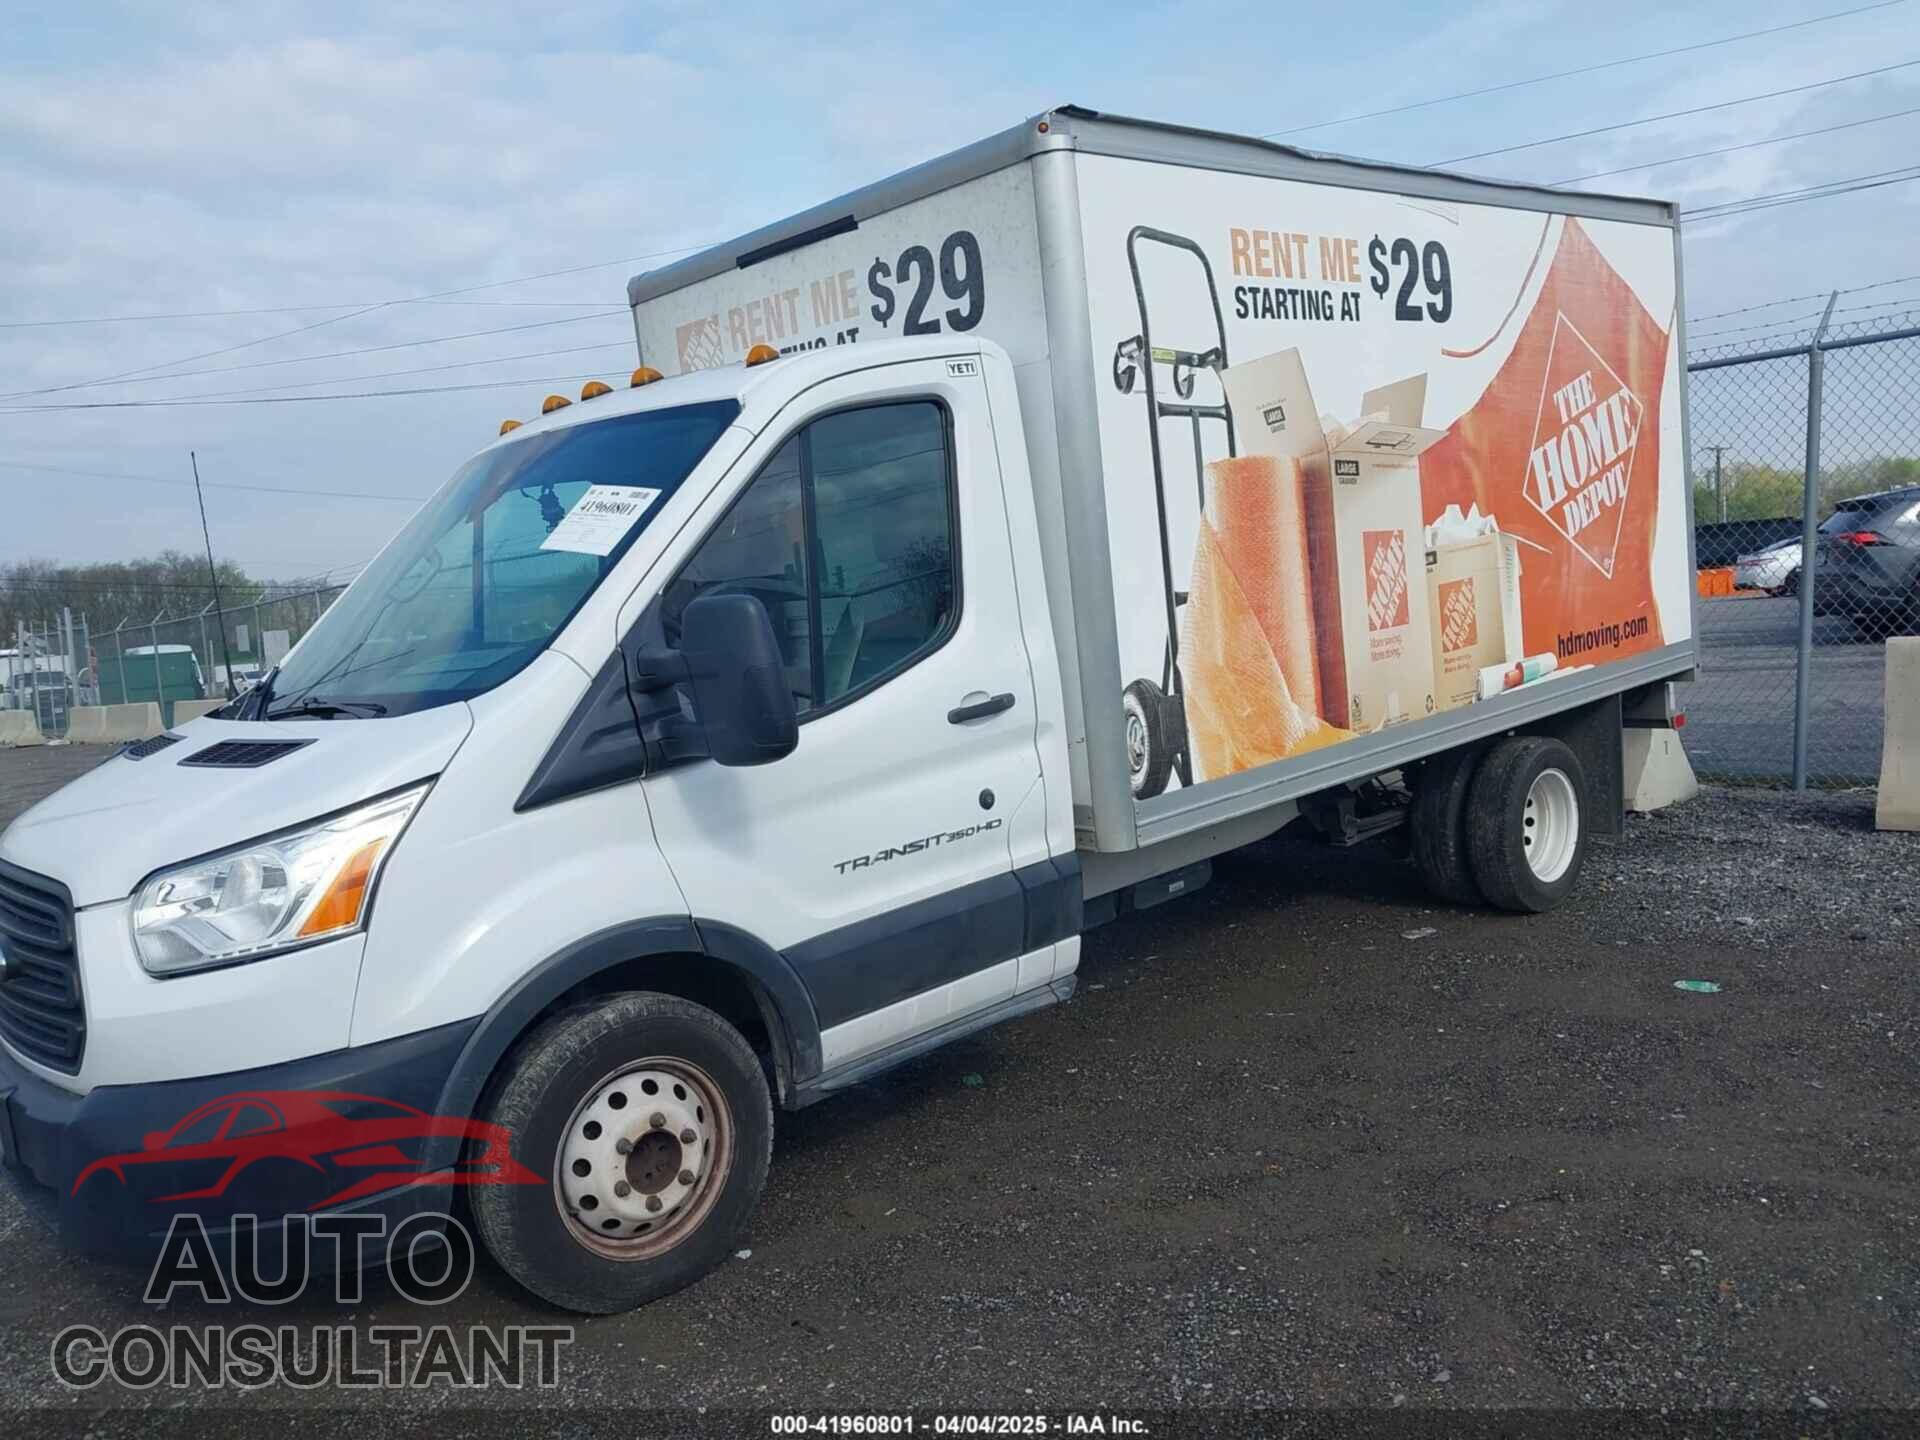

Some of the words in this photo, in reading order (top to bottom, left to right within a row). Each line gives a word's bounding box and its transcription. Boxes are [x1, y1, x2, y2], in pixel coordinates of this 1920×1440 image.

[1230, 227, 1309, 279] RENT
[1319, 236, 1362, 283] ME
[1368, 234, 1454, 323] $29
[728, 288, 801, 353] RENT
[810, 269, 860, 328] ME
[868, 230, 985, 337] $29
[1234, 285, 1334, 321] STARTING
[1340, 291, 1361, 322] AT
[948, 362, 976, 374] YETI
[1553, 370, 1596, 425] THE
[1531, 386, 1637, 513] HOME
[1562, 461, 1626, 538] DEPOT
[1558, 615, 1648, 658] hdmoving.com
[833, 832, 946, 875] TRANSIT
